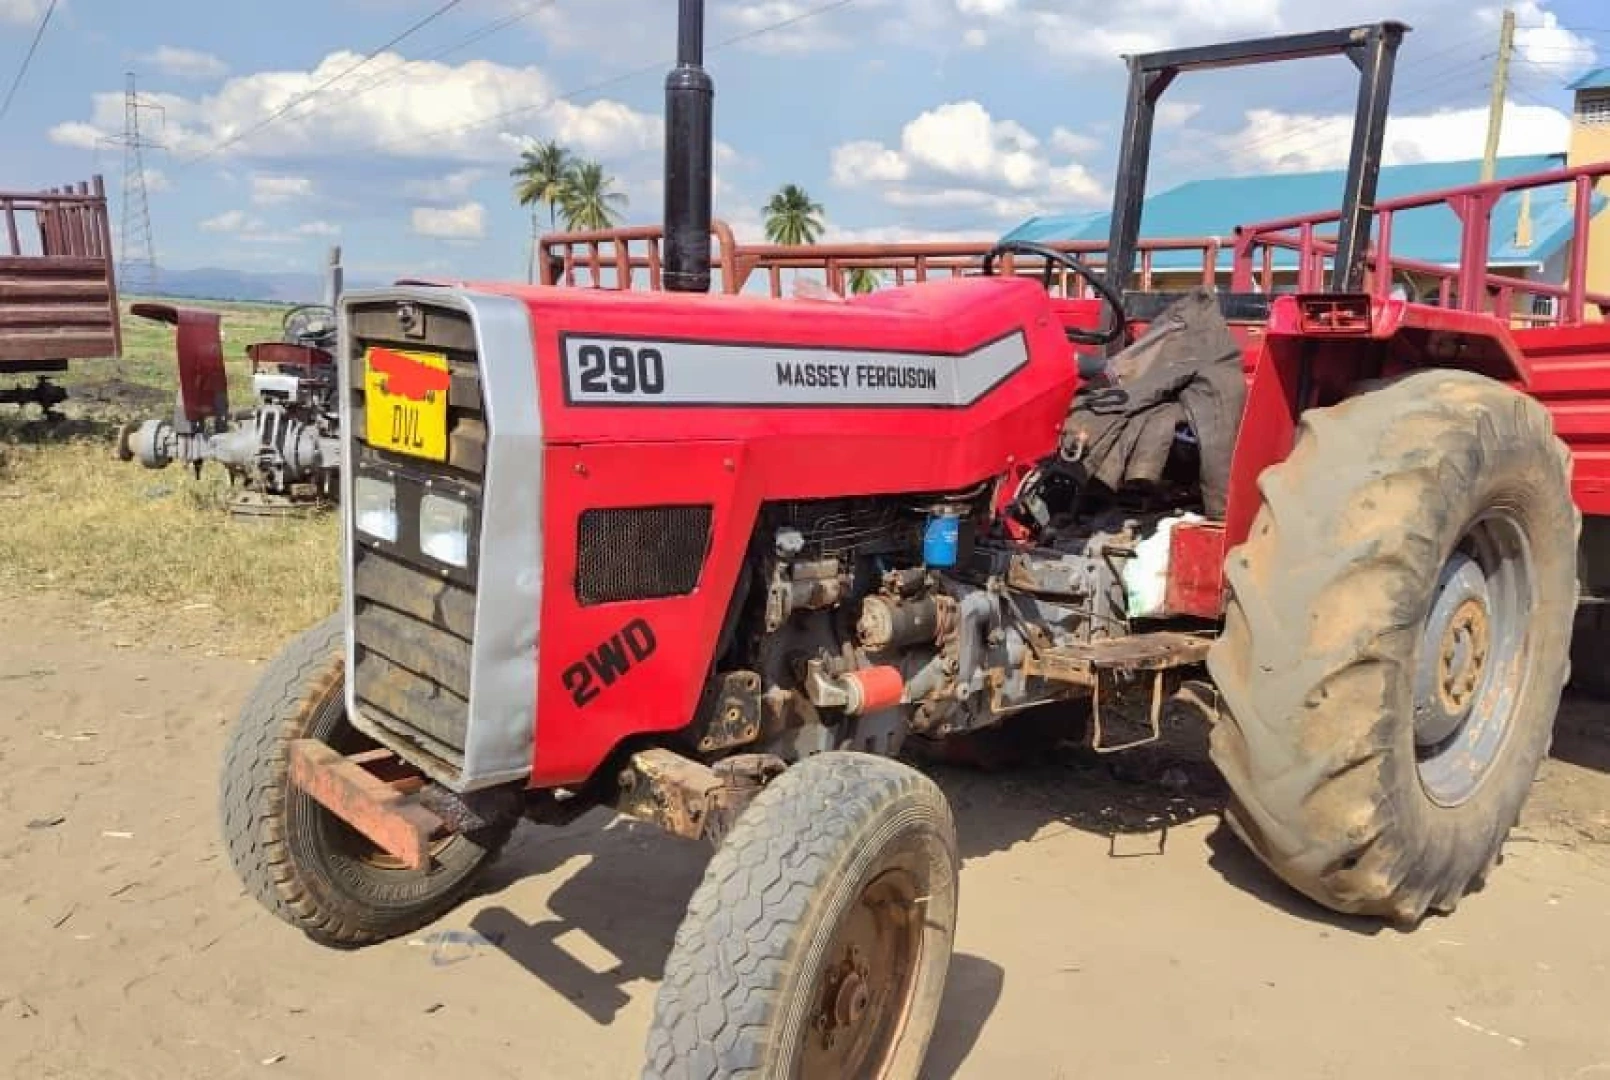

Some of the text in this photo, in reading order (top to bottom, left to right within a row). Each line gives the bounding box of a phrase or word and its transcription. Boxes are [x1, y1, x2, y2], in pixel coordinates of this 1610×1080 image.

[578, 345, 664, 394] 290
[776, 362, 937, 390] MASSEY FERGUSON
[391, 404, 424, 449] DVL
[561, 618, 656, 708] 2WD
